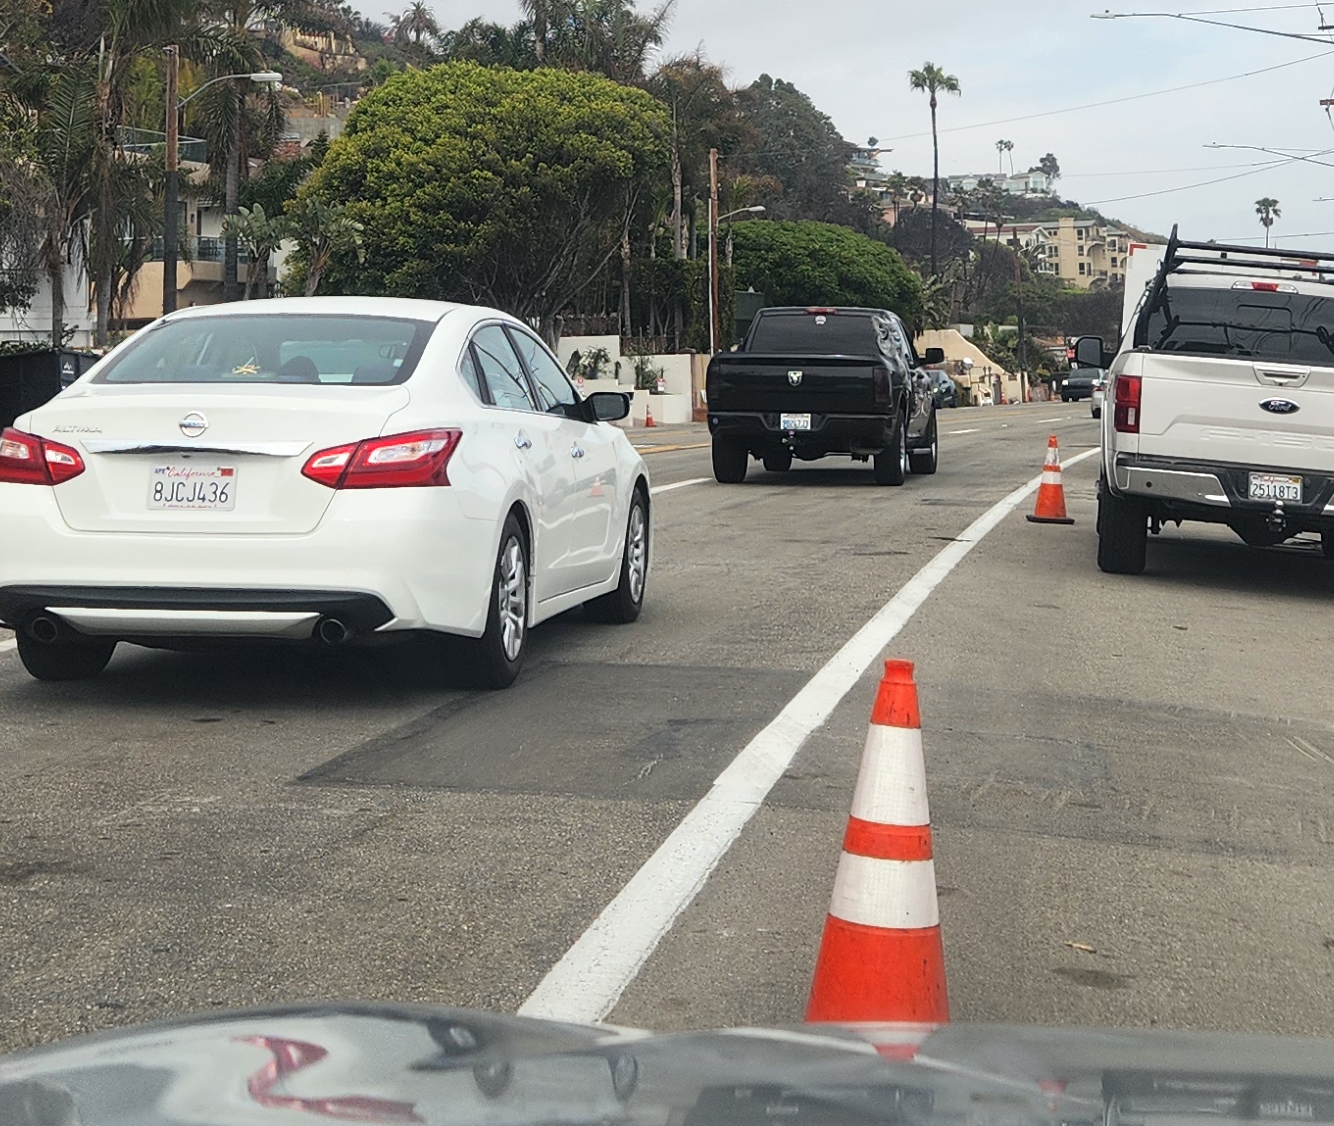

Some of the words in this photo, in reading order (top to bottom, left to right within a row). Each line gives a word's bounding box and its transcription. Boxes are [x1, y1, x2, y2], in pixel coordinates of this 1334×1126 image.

[167, 466, 217, 480] California
[153, 481, 230, 503] 8JCJ436
[1252, 483, 1299, 499] 25118T3
